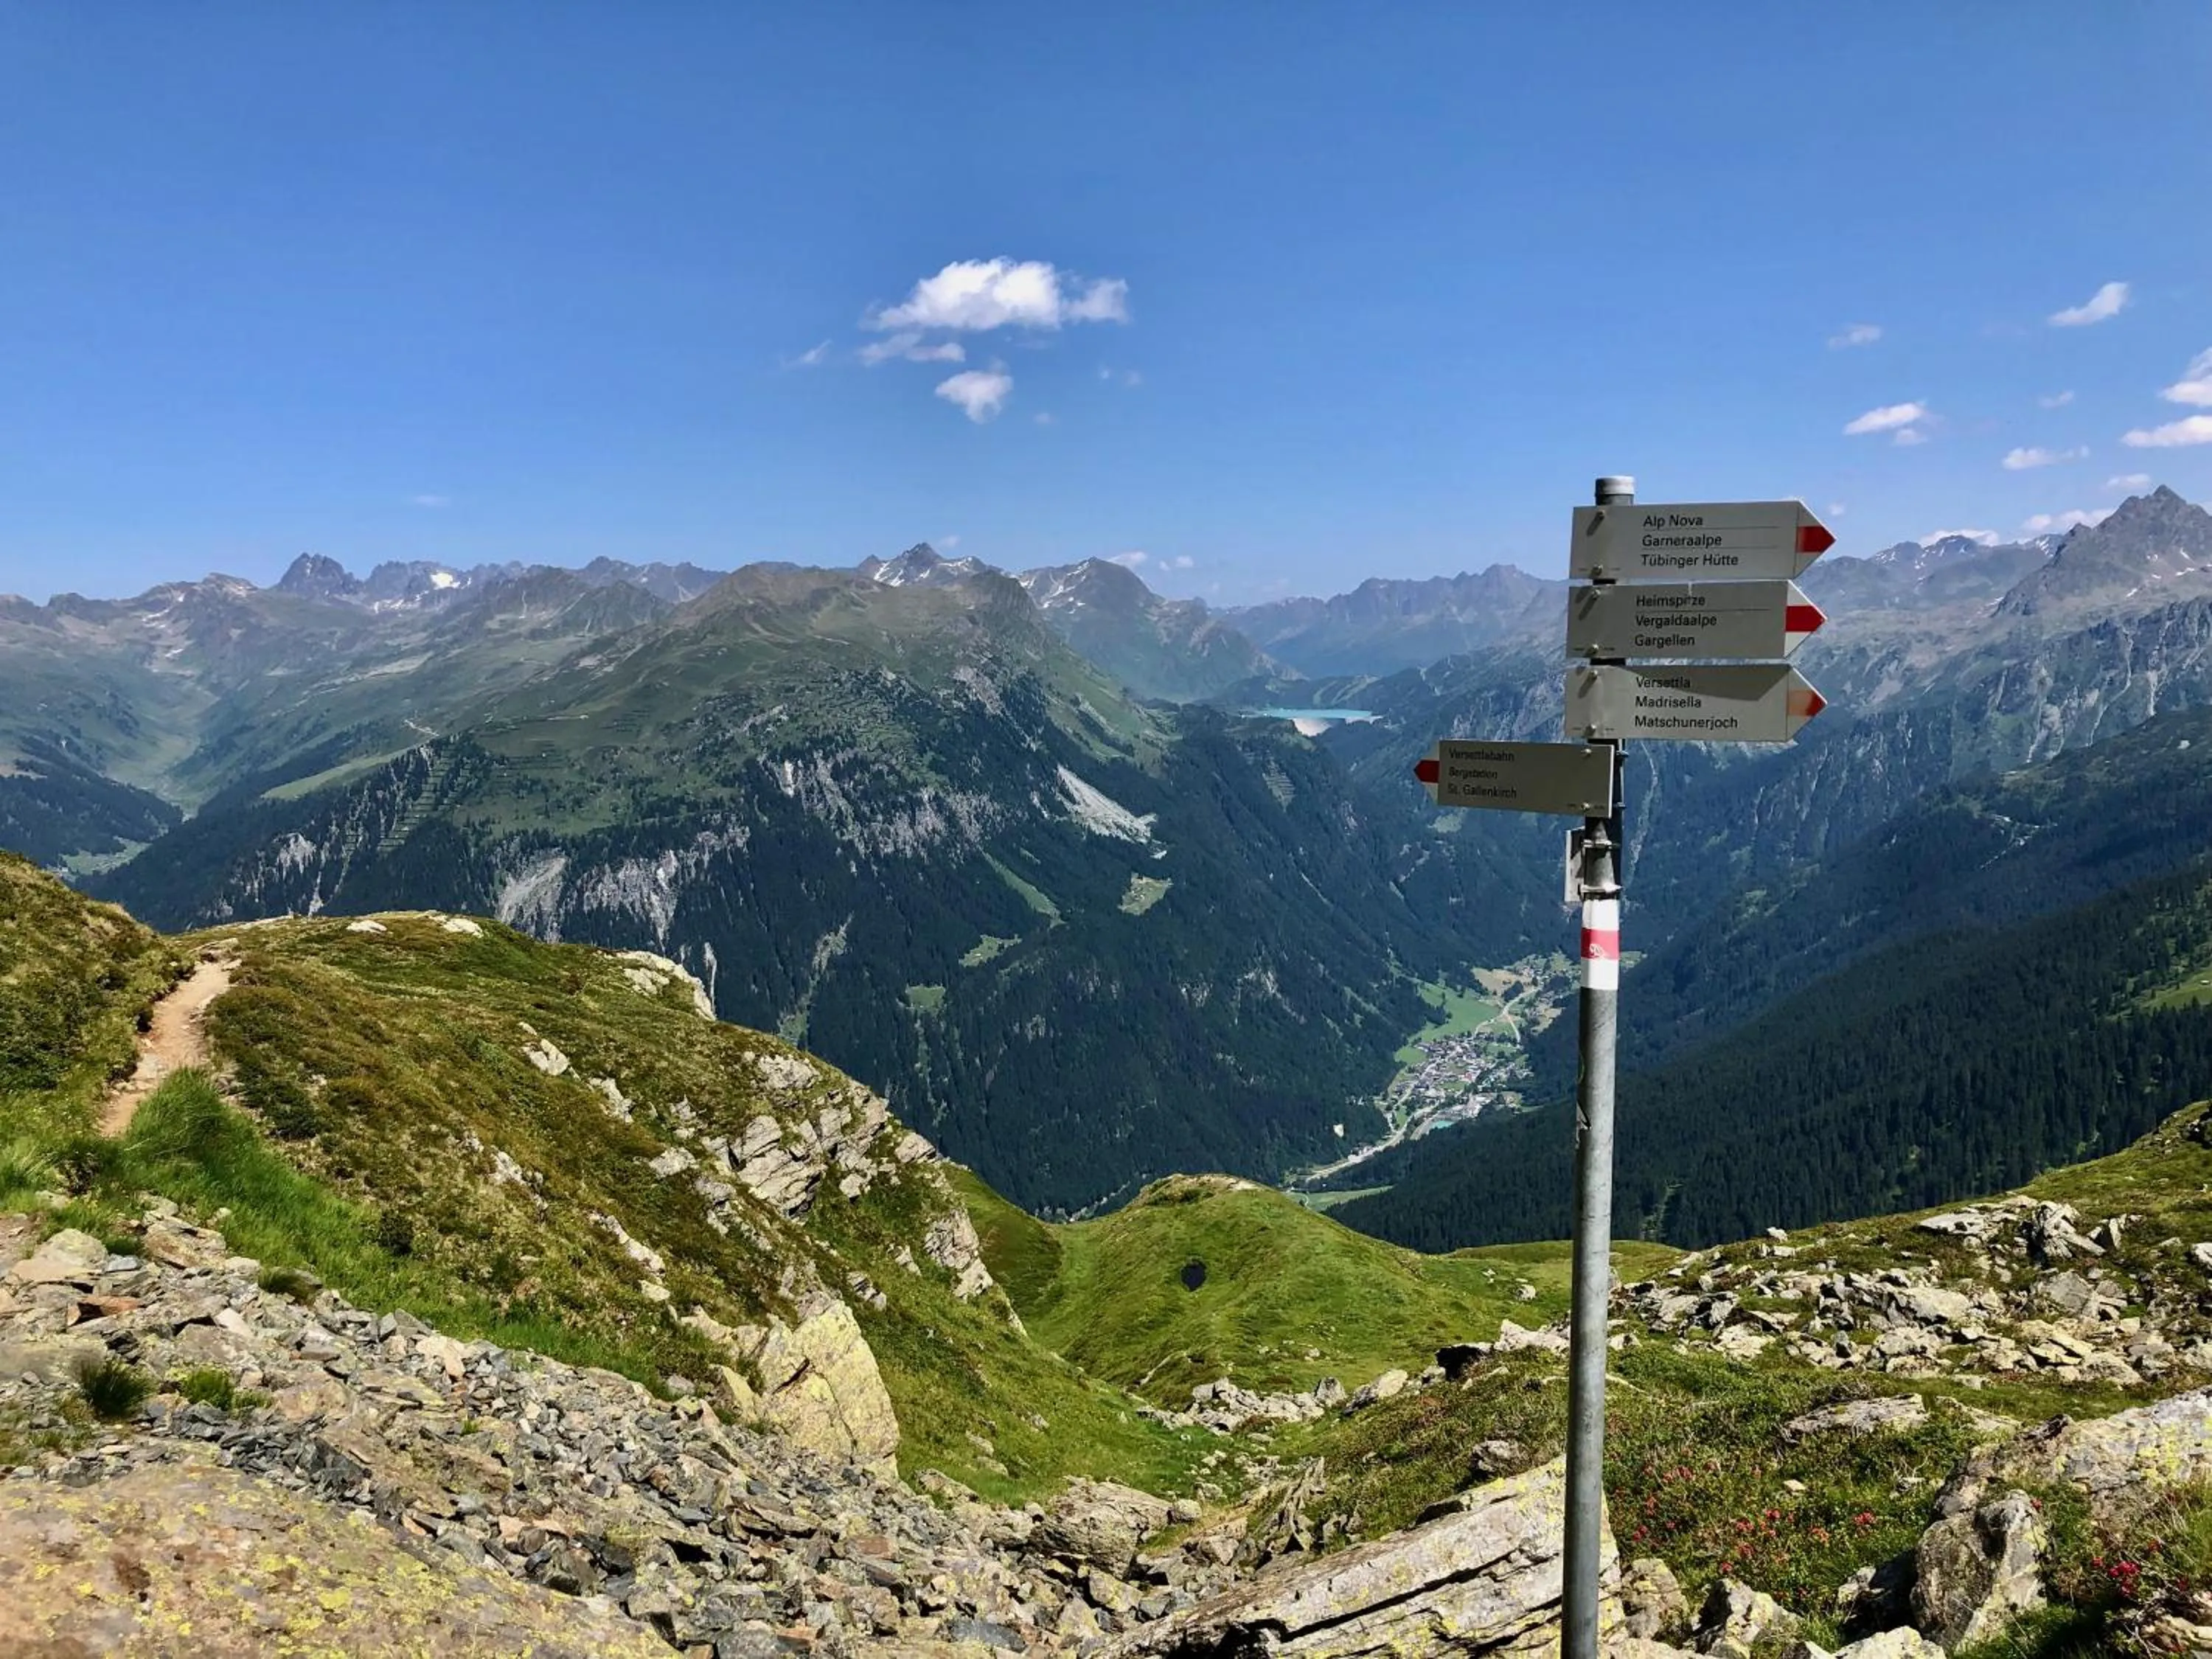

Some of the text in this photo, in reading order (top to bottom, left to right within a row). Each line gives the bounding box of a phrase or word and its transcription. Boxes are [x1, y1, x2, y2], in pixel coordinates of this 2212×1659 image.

[1643, 515, 1703, 529] Alp Nova
[1641, 534, 1722, 549] Garneraalpe
[1641, 554, 1739, 568] Tübinger Hütte
[1636, 594, 1705, 608] Heimspitze
[1635, 614, 1717, 629] Vergaldaalpe
[1635, 634, 1695, 649] Gargellen
[1636, 676, 1691, 688] Versettla
[1635, 695, 1702, 708] Madrisella
[1635, 715, 1738, 730] Matschunerjoch
